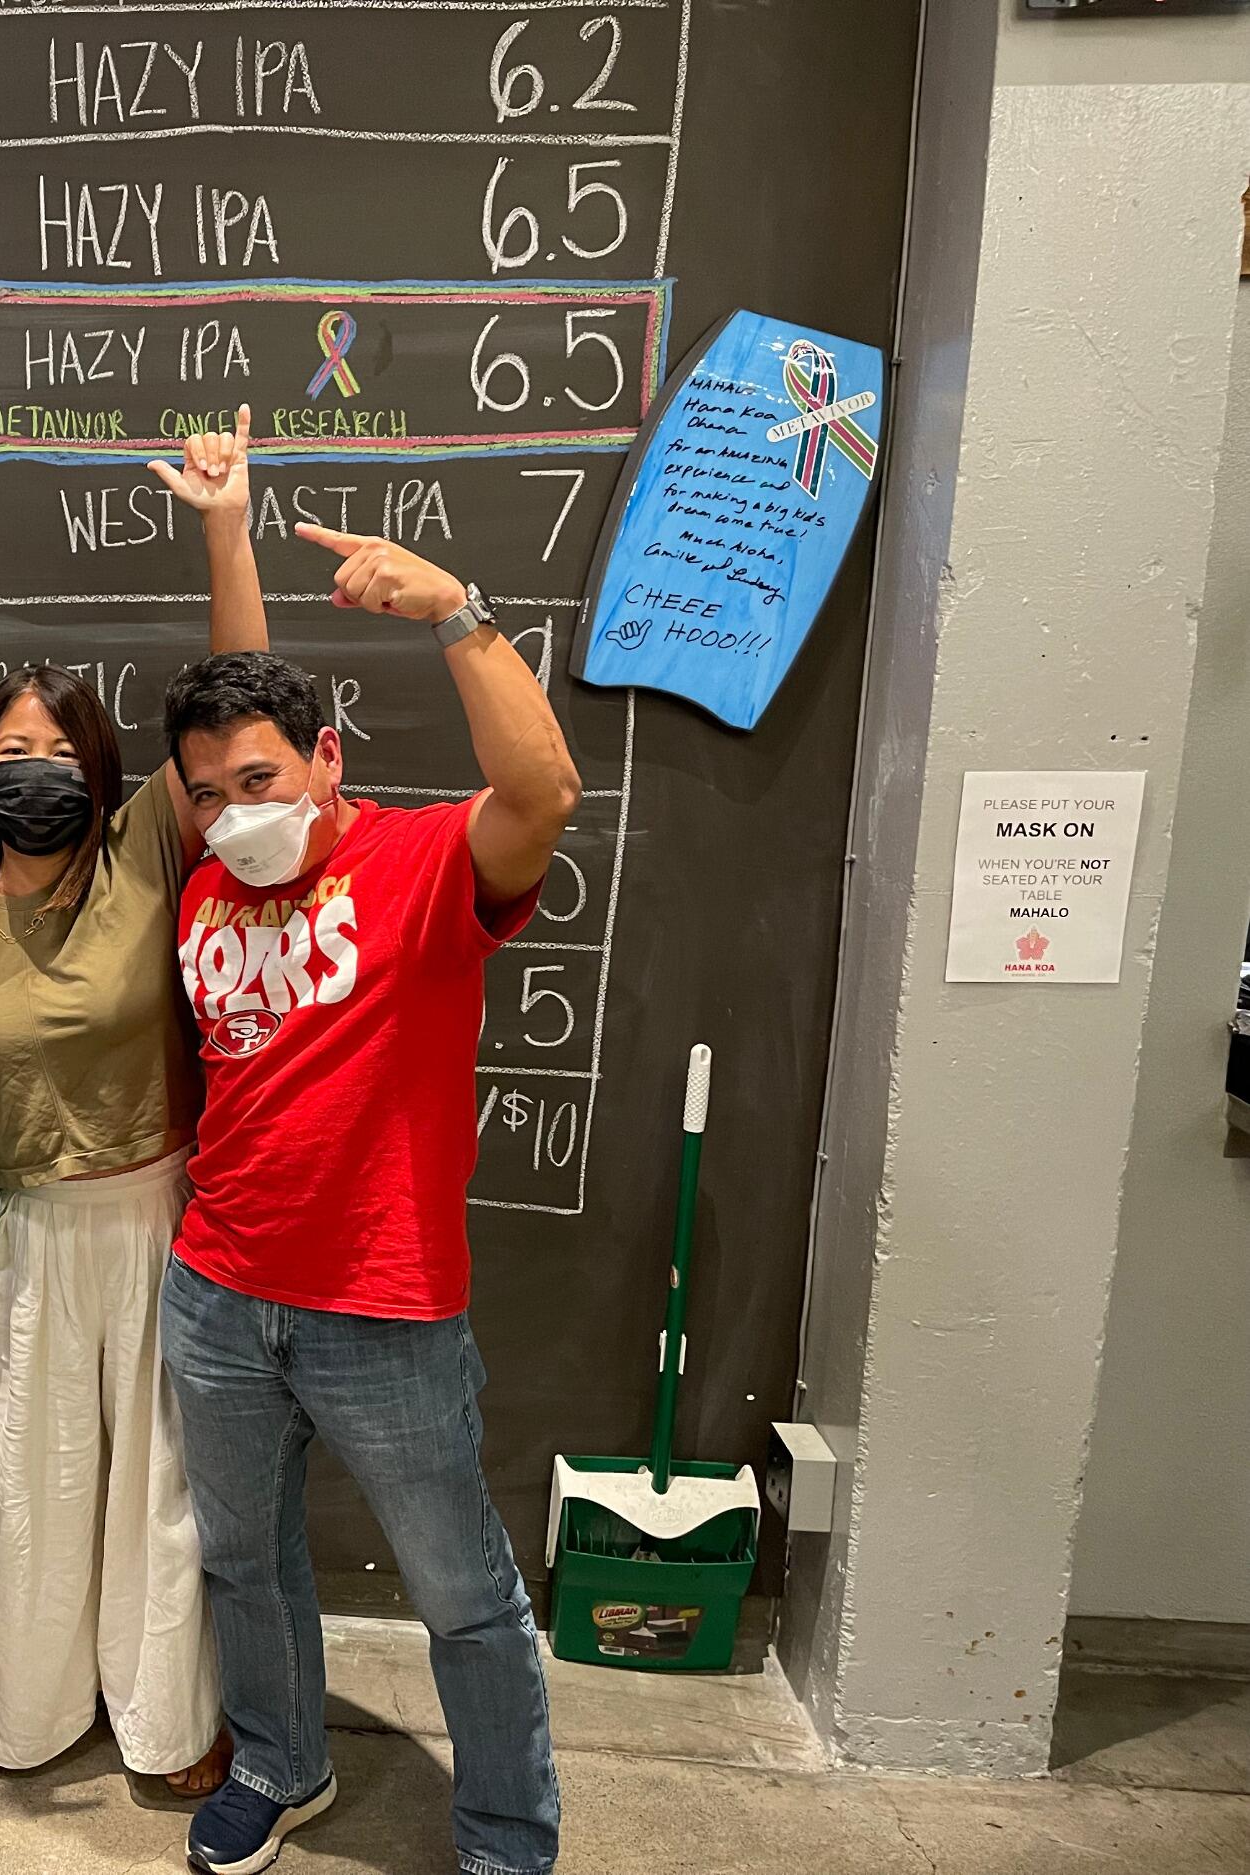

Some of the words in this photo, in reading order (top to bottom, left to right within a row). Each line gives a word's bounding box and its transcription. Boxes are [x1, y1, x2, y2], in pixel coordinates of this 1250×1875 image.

[49, 36, 204, 126] HAZY
[236, 35, 322, 116] IPA
[489, 14, 638, 124] 6.2
[39, 174, 163, 276] HAZY
[195, 184, 280, 266] IPA
[481, 157, 629, 275] 6.5
[25, 325, 145, 391] HAZY
[180, 319, 251, 381] IPA
[470, 308, 625, 413] 6.5
[159, 408, 245, 438] CANCE
[273, 408, 408, 439] RESEARCH
[684, 397, 735, 414] Hana
[772, 393, 871, 438] METAVIVOR
[664, 438, 693, 456] for
[60, 486, 176, 553] WEST
[383, 479, 452, 541] IPA
[520, 469, 586, 562] 7
[663, 483, 687, 498] for
[691, 489, 748, 513] making
[764, 501, 789, 522] big
[625, 583, 723, 618] CHEEE
[663, 619, 772, 658] HOOO!!!
[983, 800, 1037, 810] PLEASE
[1041, 800, 1069, 810] PUT
[1074, 800, 1115, 810] YOUR
[996, 823, 1057, 837] MASK
[1063, 823, 1095, 837] ON
[978, 859, 1020, 869] WHEN
[1024, 859, 1076, 869] YOU'RE
[1080, 859, 1110, 869] NOT
[982, 875, 1037, 885] SEATED
[1040, 875, 1059, 885] AT
[1063, 875, 1103, 885] YOUR
[1009, 907, 1069, 918] MAHALO
[1020, 890, 1062, 901] TABLE
